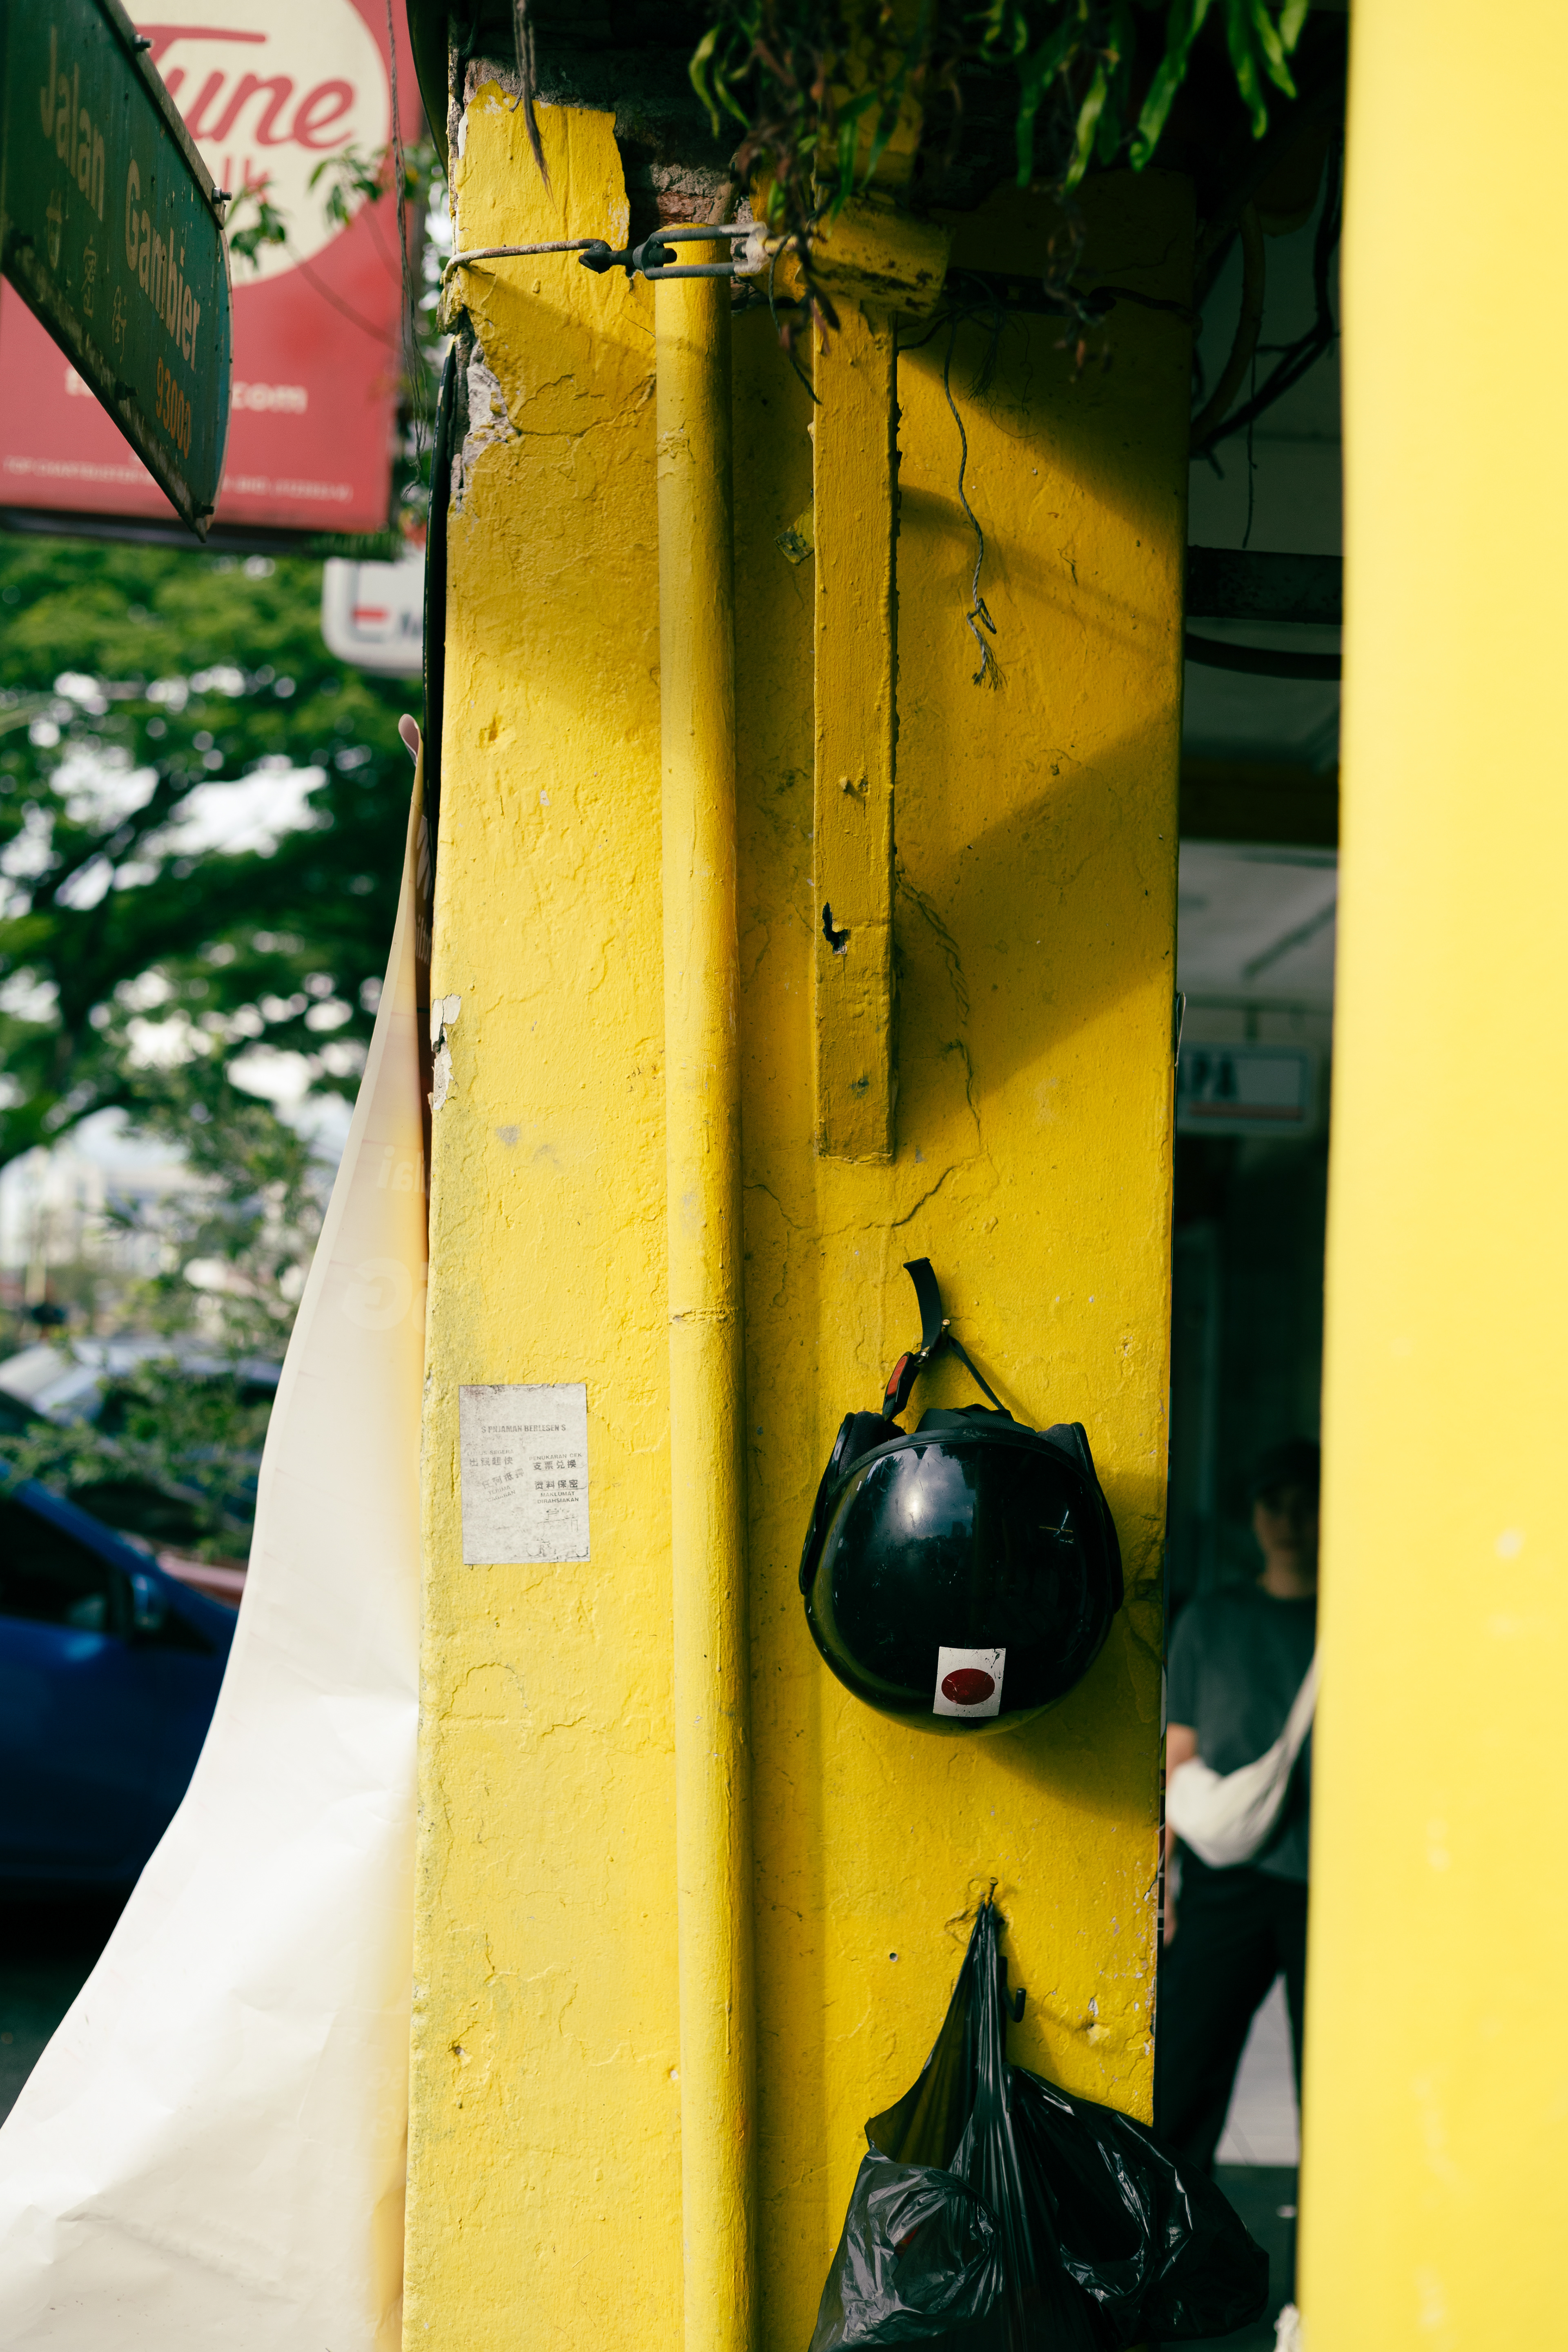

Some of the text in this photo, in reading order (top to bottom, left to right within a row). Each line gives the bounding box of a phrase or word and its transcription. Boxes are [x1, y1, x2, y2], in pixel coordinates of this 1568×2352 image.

[41, 24, 201, 372] Jalan Gambier
[156, 356, 191, 460] 93000
[532, 1459, 577, 1470] 支票兑换
[488, 1485, 511, 1495] TERIMA
[535, 1479, 578, 1490] 资料保密
[487, 1490, 516, 1502] CAGARAN
